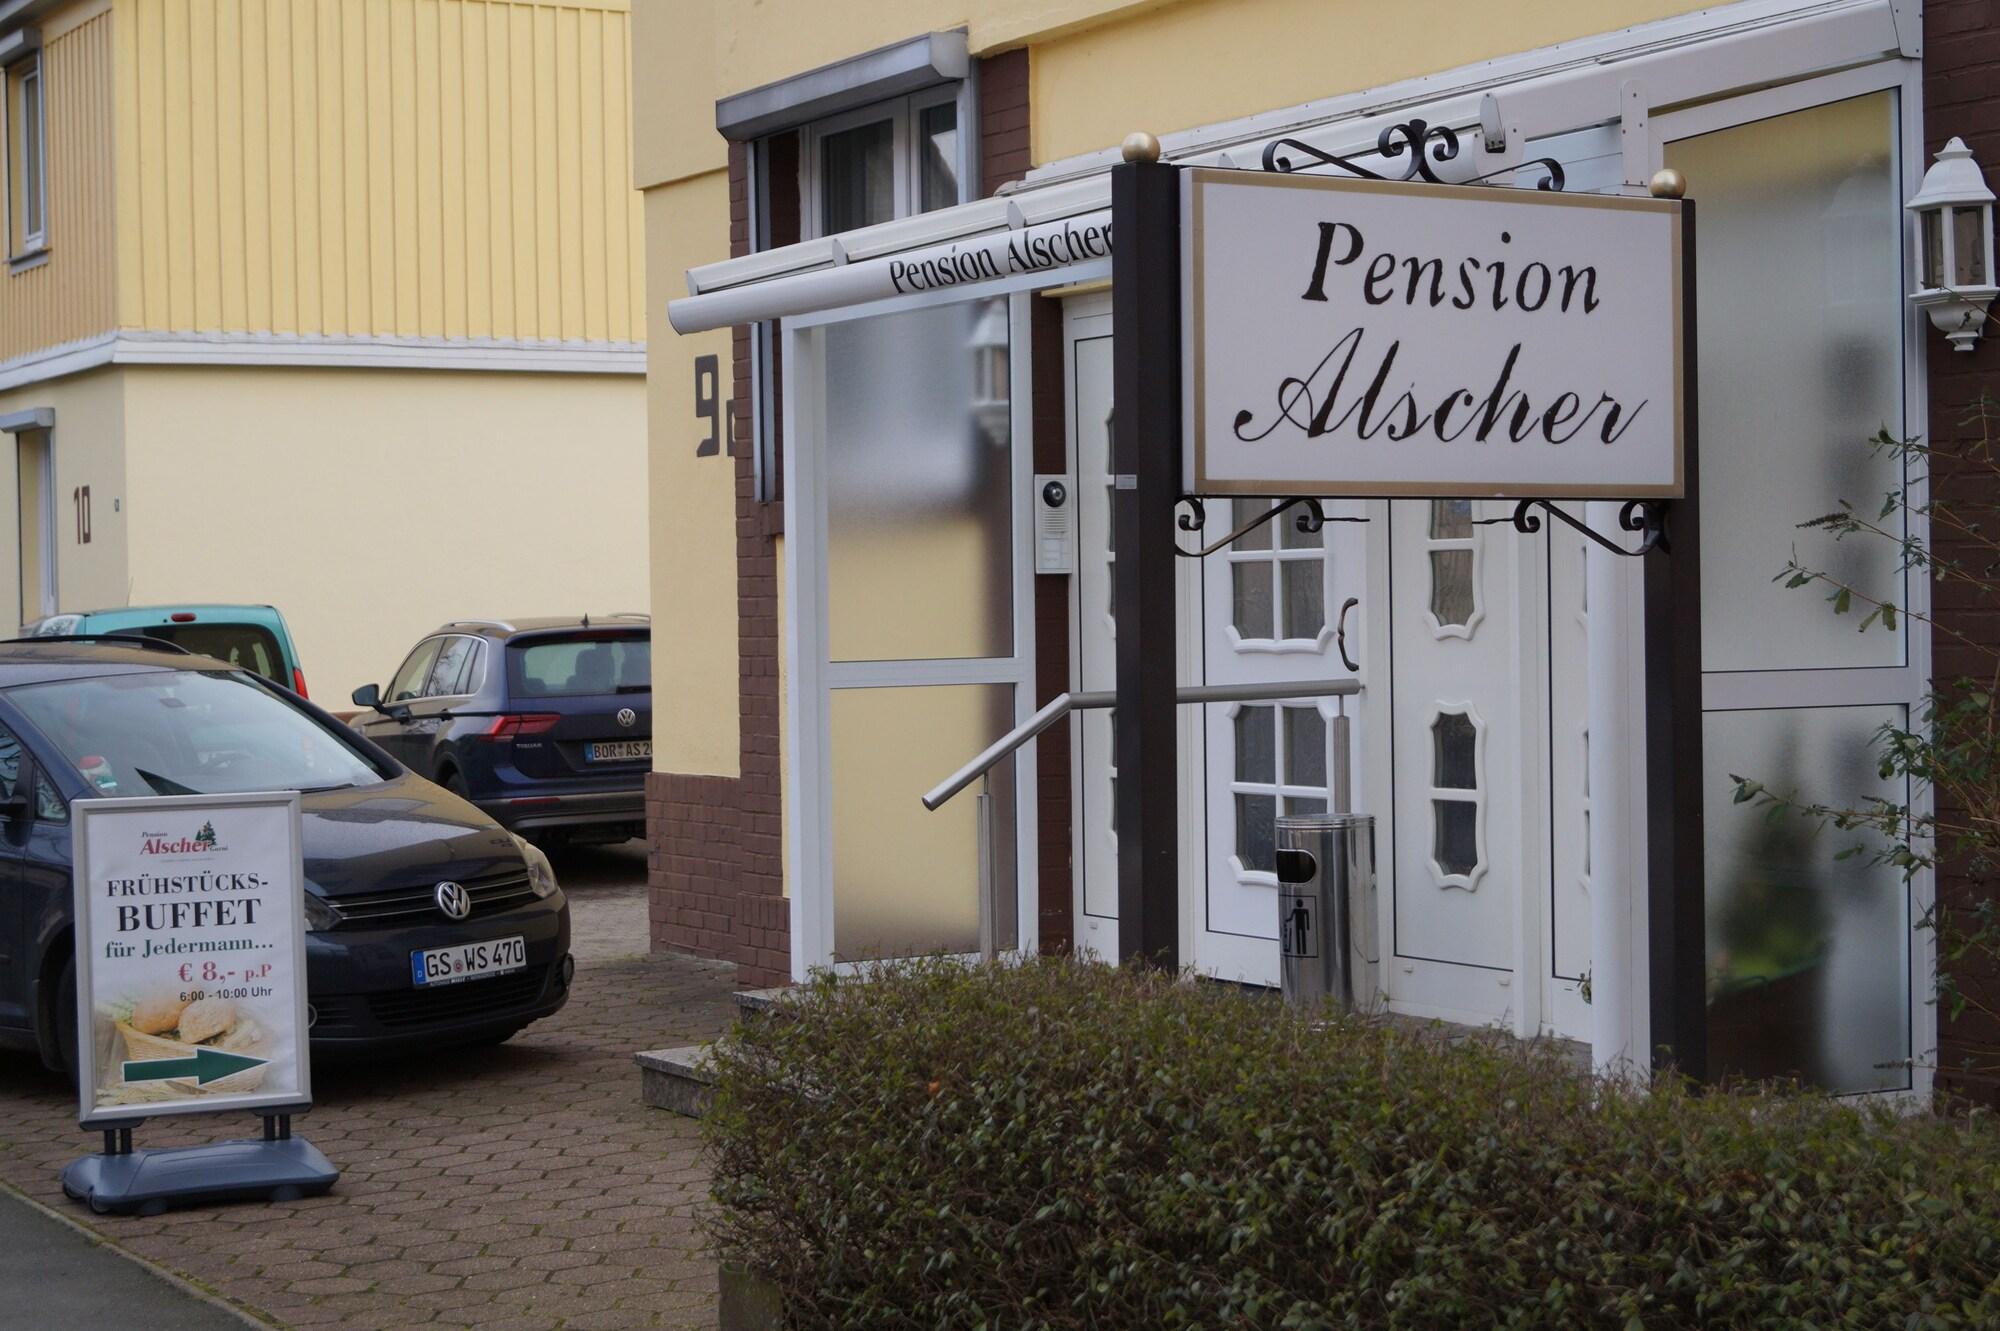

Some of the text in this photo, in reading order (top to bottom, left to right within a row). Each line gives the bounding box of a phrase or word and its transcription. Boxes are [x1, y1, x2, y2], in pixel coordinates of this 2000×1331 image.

[889, 220, 1113, 294] Pension Alscher
[1300, 221, 1600, 314] Pension
[1233, 327, 1649, 445] Alscher
[73, 485, 91, 545] 10
[594, 742, 653, 758] BOR AS 2
[140, 836, 209, 856] Alscher
[106, 870, 269, 897] FRÜHSTÜCKS-
[116, 898, 262, 932] BUFFET
[105, 937, 274, 959] für Jedermann...
[425, 952, 451, 978] GS
[464, 946, 488, 971] WS
[492, 940, 524, 966] 470
[178, 963, 193, 982] €
[202, 961, 236, 984] 8,-
[180, 990, 205, 1002] 6:00
[216, 987, 248, 999] 10:00
[251, 985, 272, 998] Uhr
